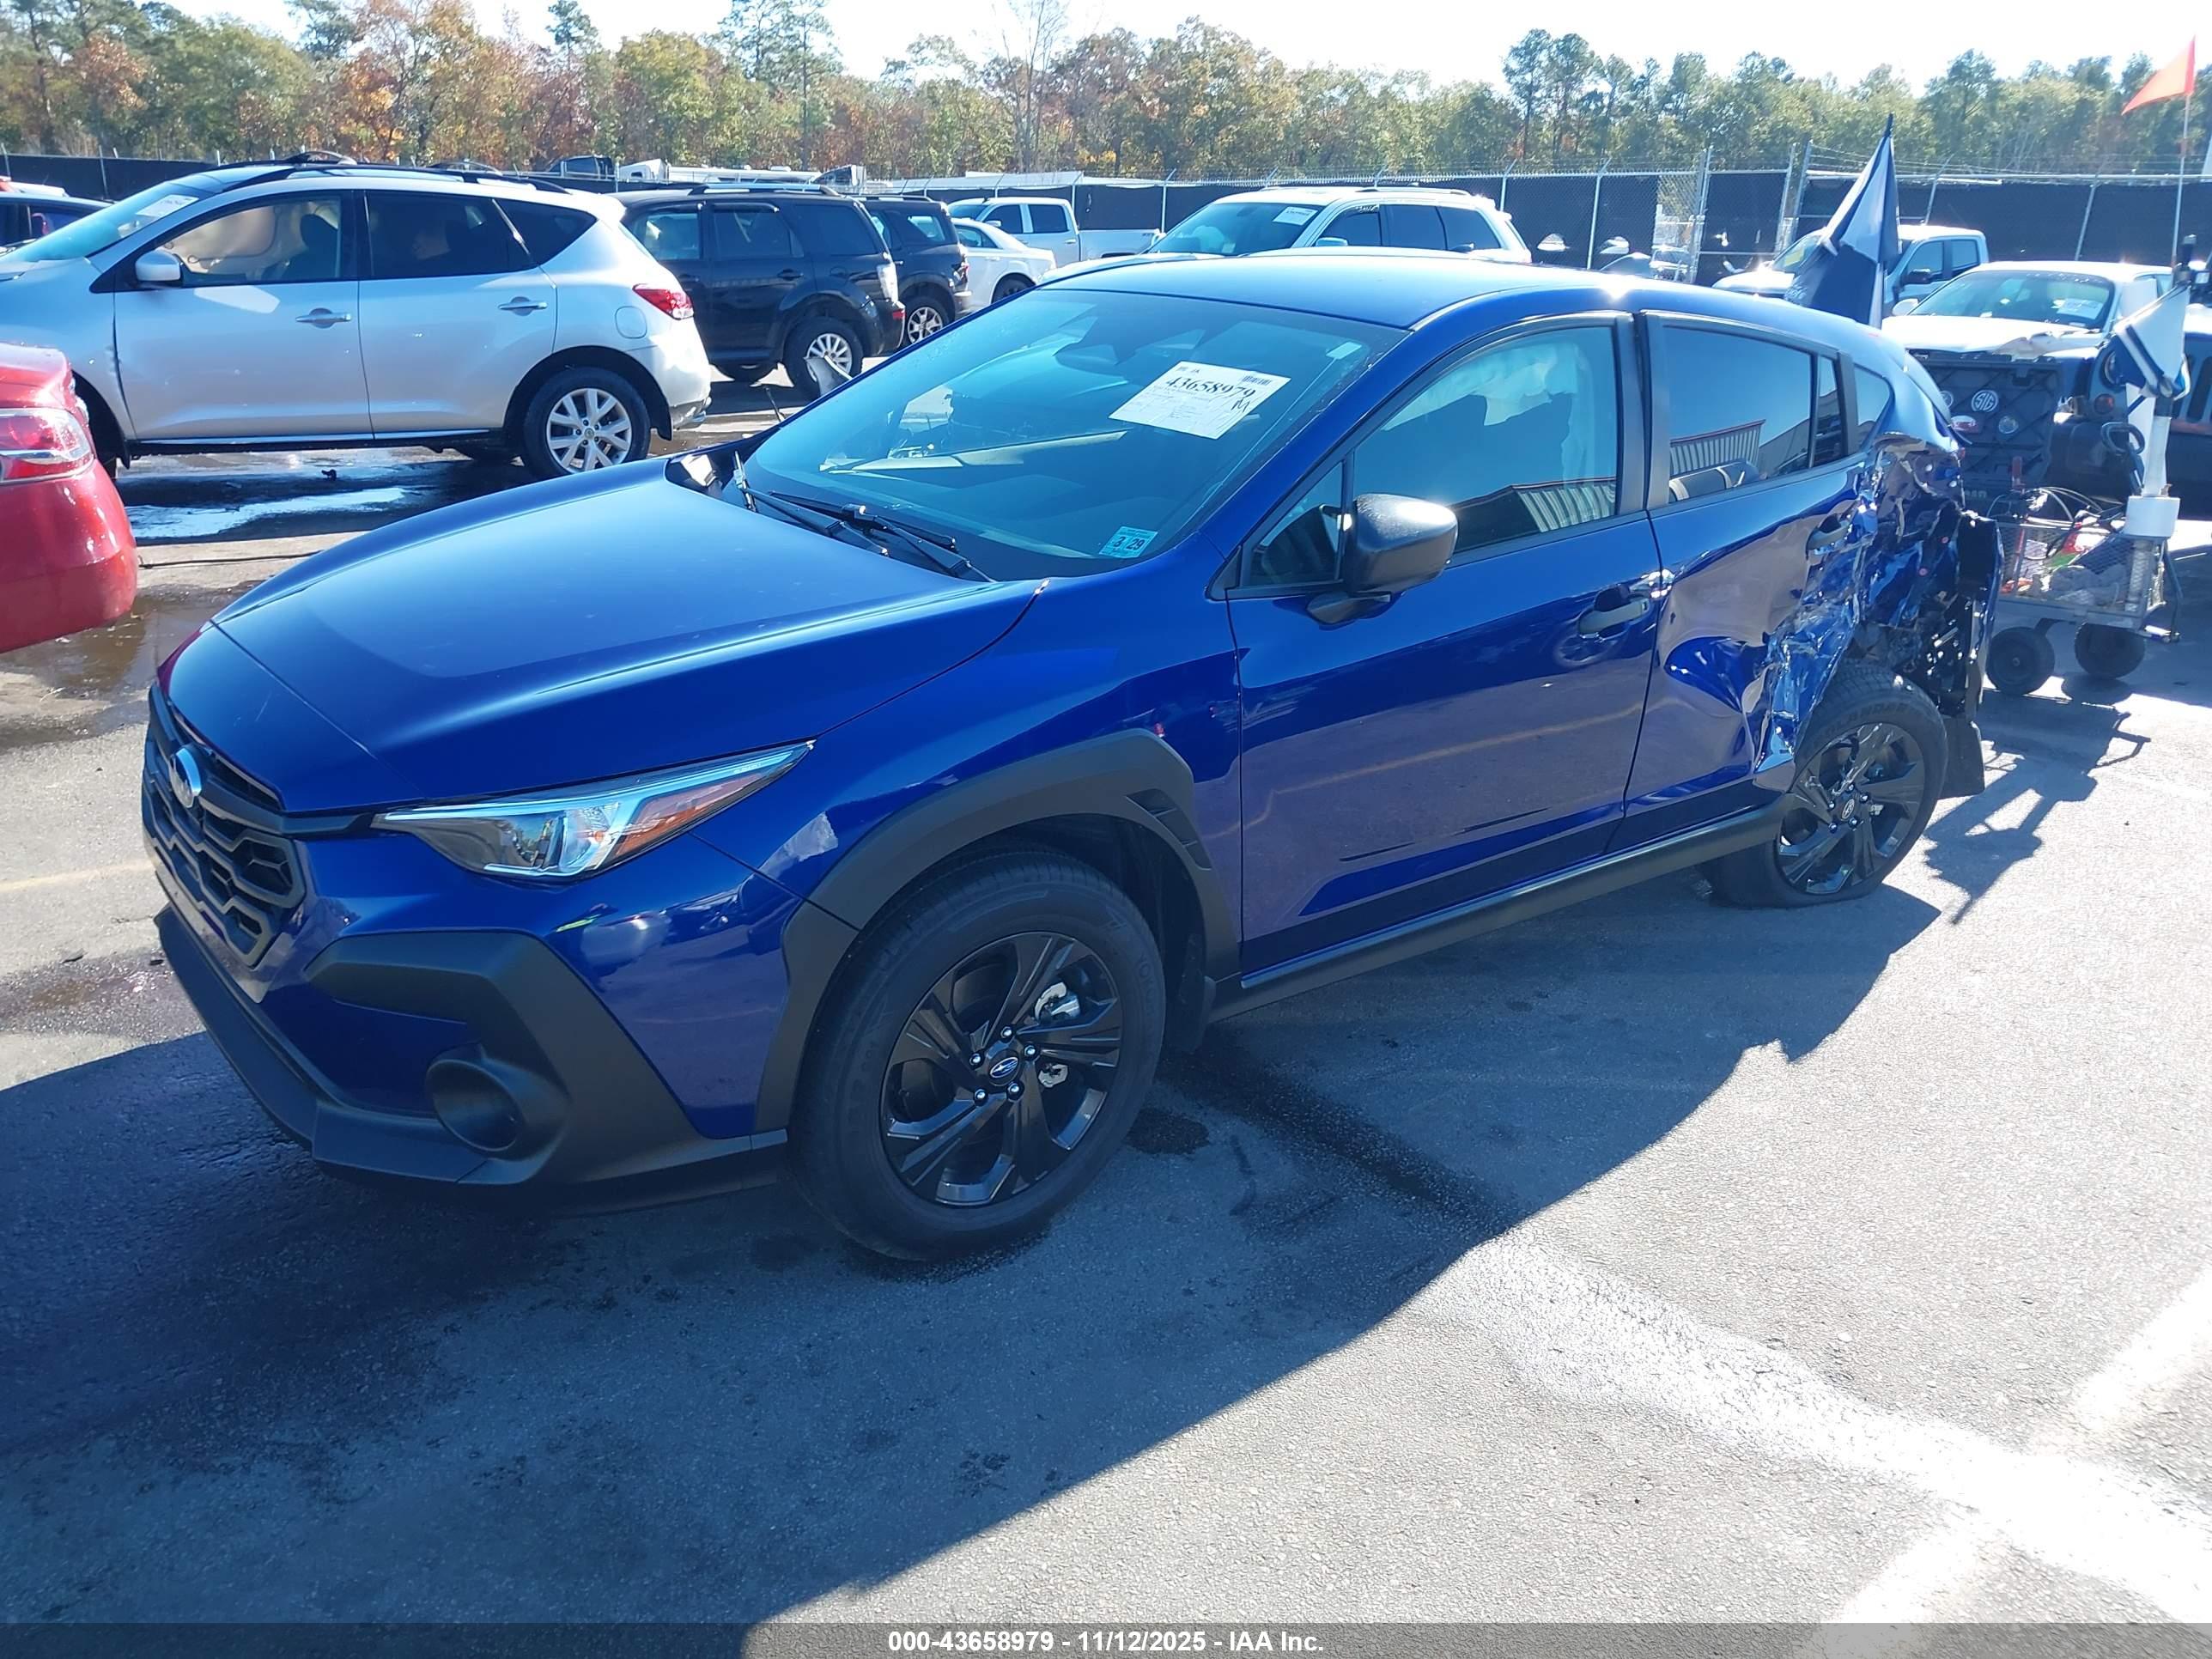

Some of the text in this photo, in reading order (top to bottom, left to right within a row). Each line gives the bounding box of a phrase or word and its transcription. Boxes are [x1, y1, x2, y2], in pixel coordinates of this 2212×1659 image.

[1166, 376, 1256, 398] 43658979
[1113, 535, 1146, 550] 3 29
